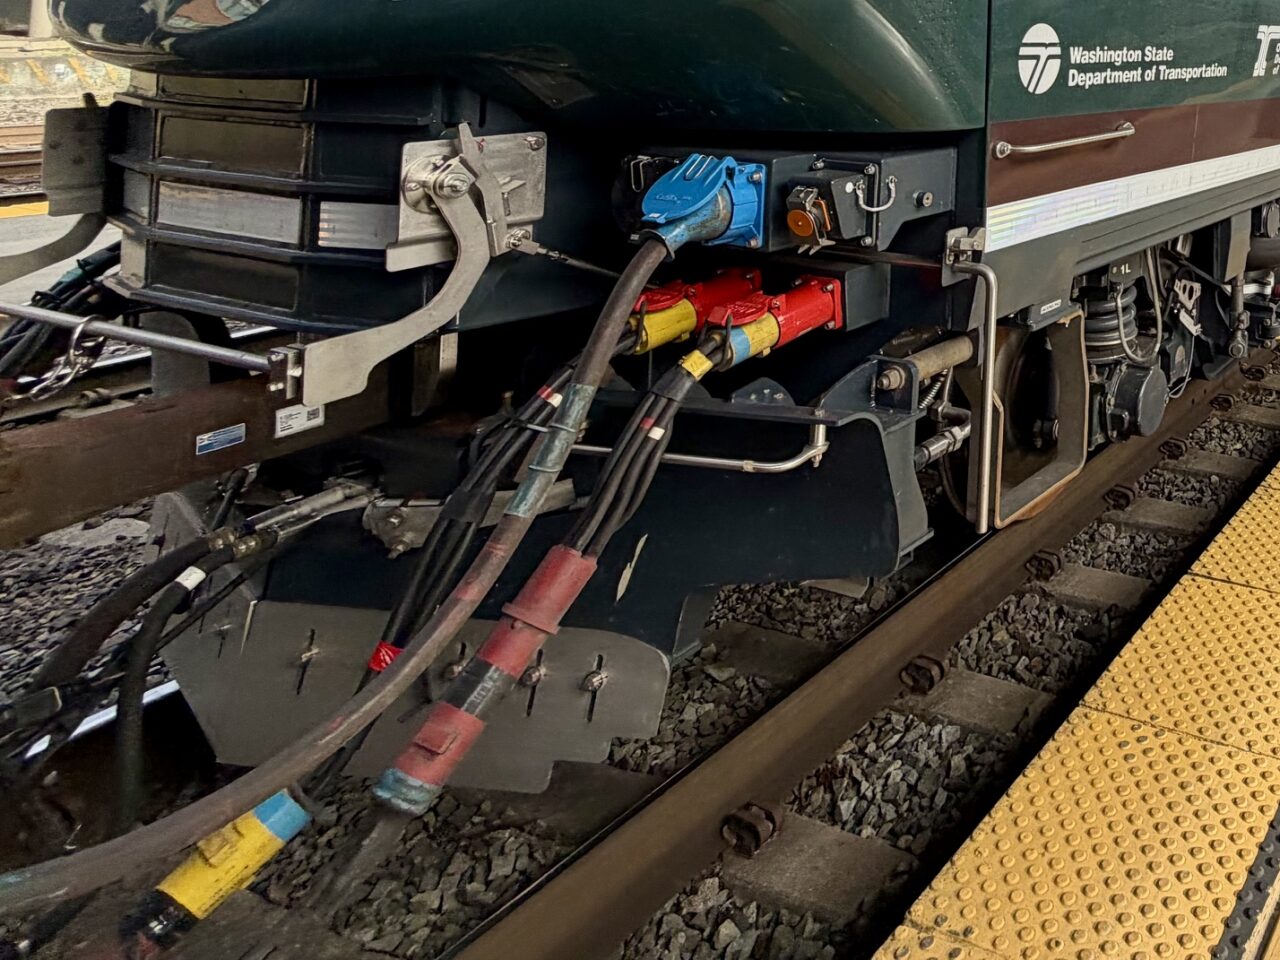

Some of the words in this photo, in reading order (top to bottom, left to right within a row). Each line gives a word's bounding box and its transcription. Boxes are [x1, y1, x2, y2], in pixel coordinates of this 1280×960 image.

[1069, 46, 1142, 66] Washington
[1144, 45, 1174, 62] State
[1068, 67, 1142, 89] Department
[1144, 65, 1157, 81] of
[1158, 62, 1228, 82] Transportation
[1272, 64, 1280, 75] of
